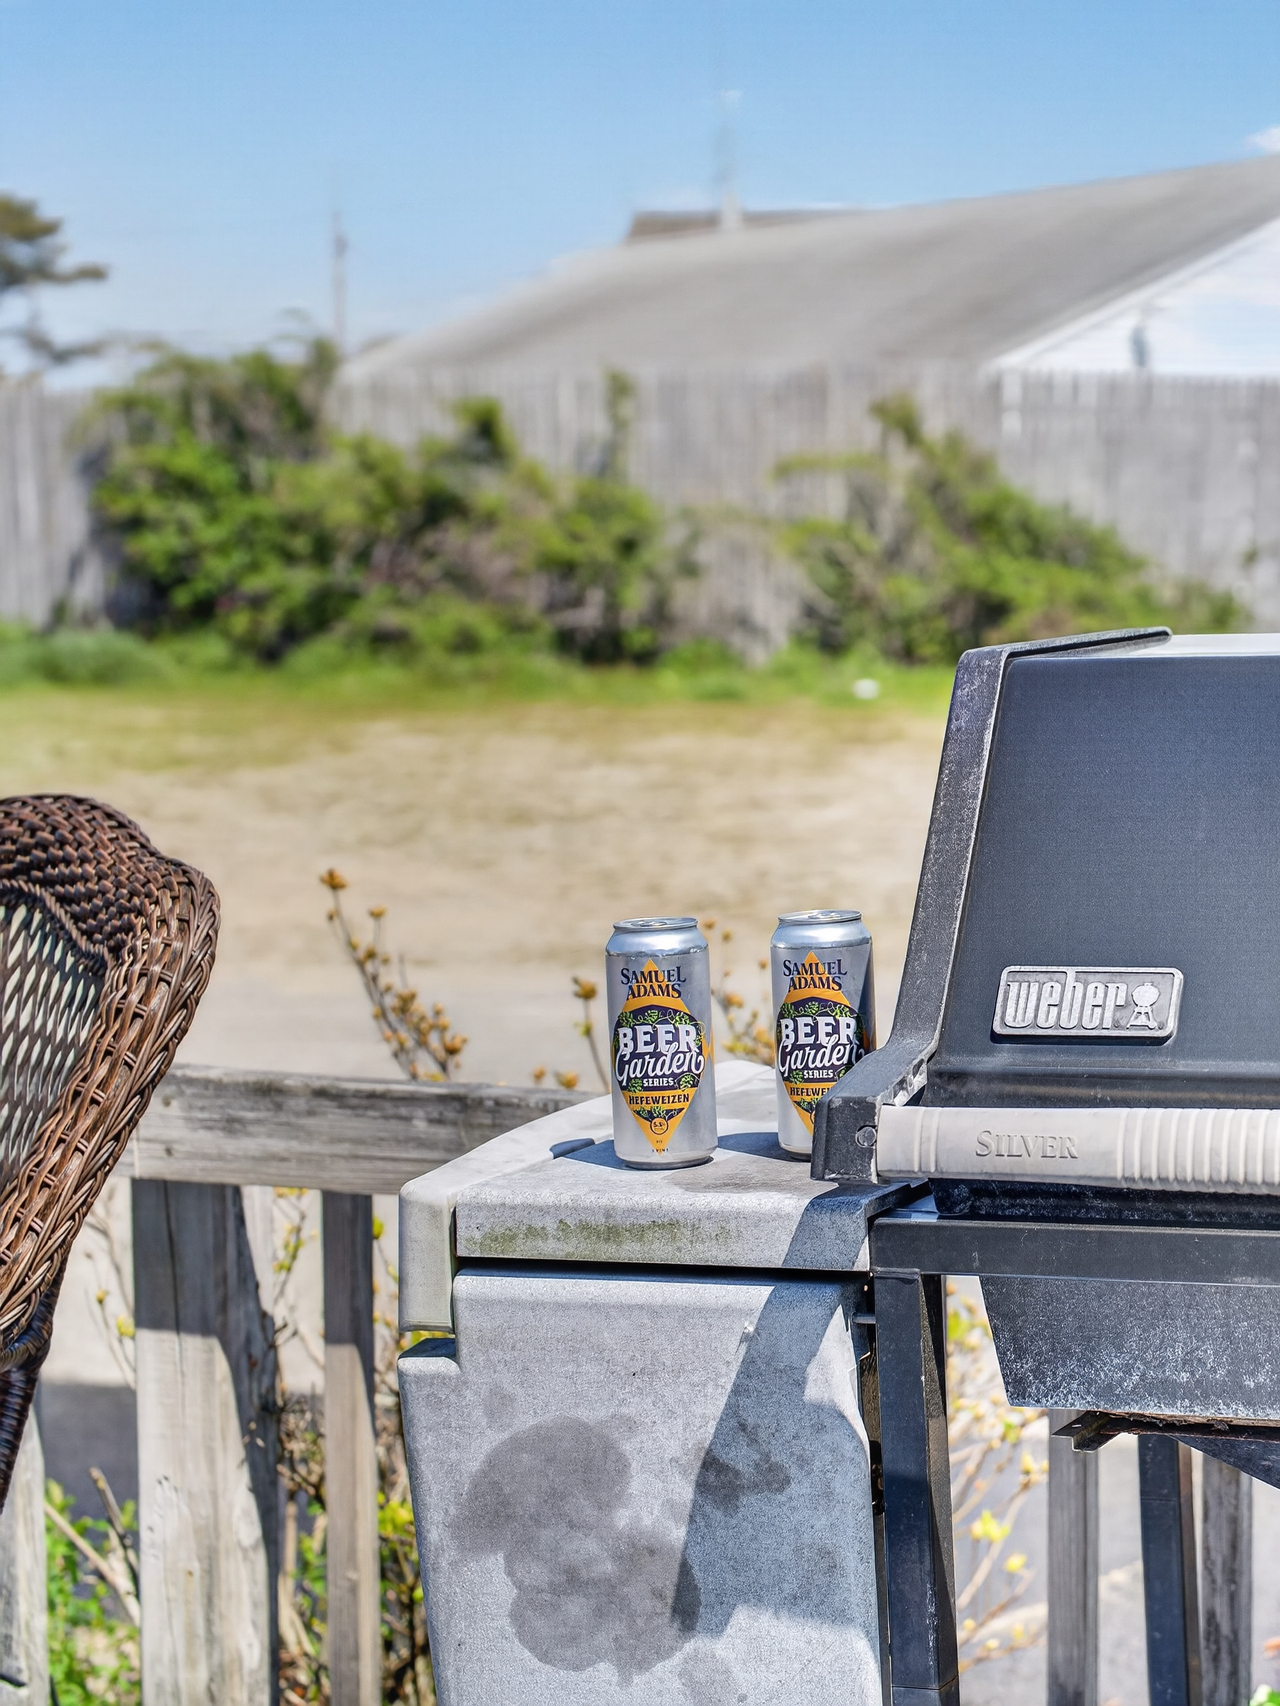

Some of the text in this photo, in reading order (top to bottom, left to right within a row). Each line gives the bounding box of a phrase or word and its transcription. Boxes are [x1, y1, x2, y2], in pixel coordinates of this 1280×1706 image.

[620, 966, 687, 985] SAMUEL
[783, 959, 848, 977] SAMUEL
[627, 983, 682, 1000] ADAMS
[788, 976, 842, 993] ADAMS
[1004, 971, 1128, 1030] weber
[617, 1024, 700, 1053] BEER
[780, 1016, 860, 1045] BEER
[615, 1042, 705, 1087] Garden
[778, 1034, 865, 1077] Garden
[642, 1077, 674, 1088] SERIES
[803, 1069, 834, 1079] SERIES
[629, 1093, 690, 1106] HEFEWEIZEN
[975, 1130, 1079, 1159] SILVER
